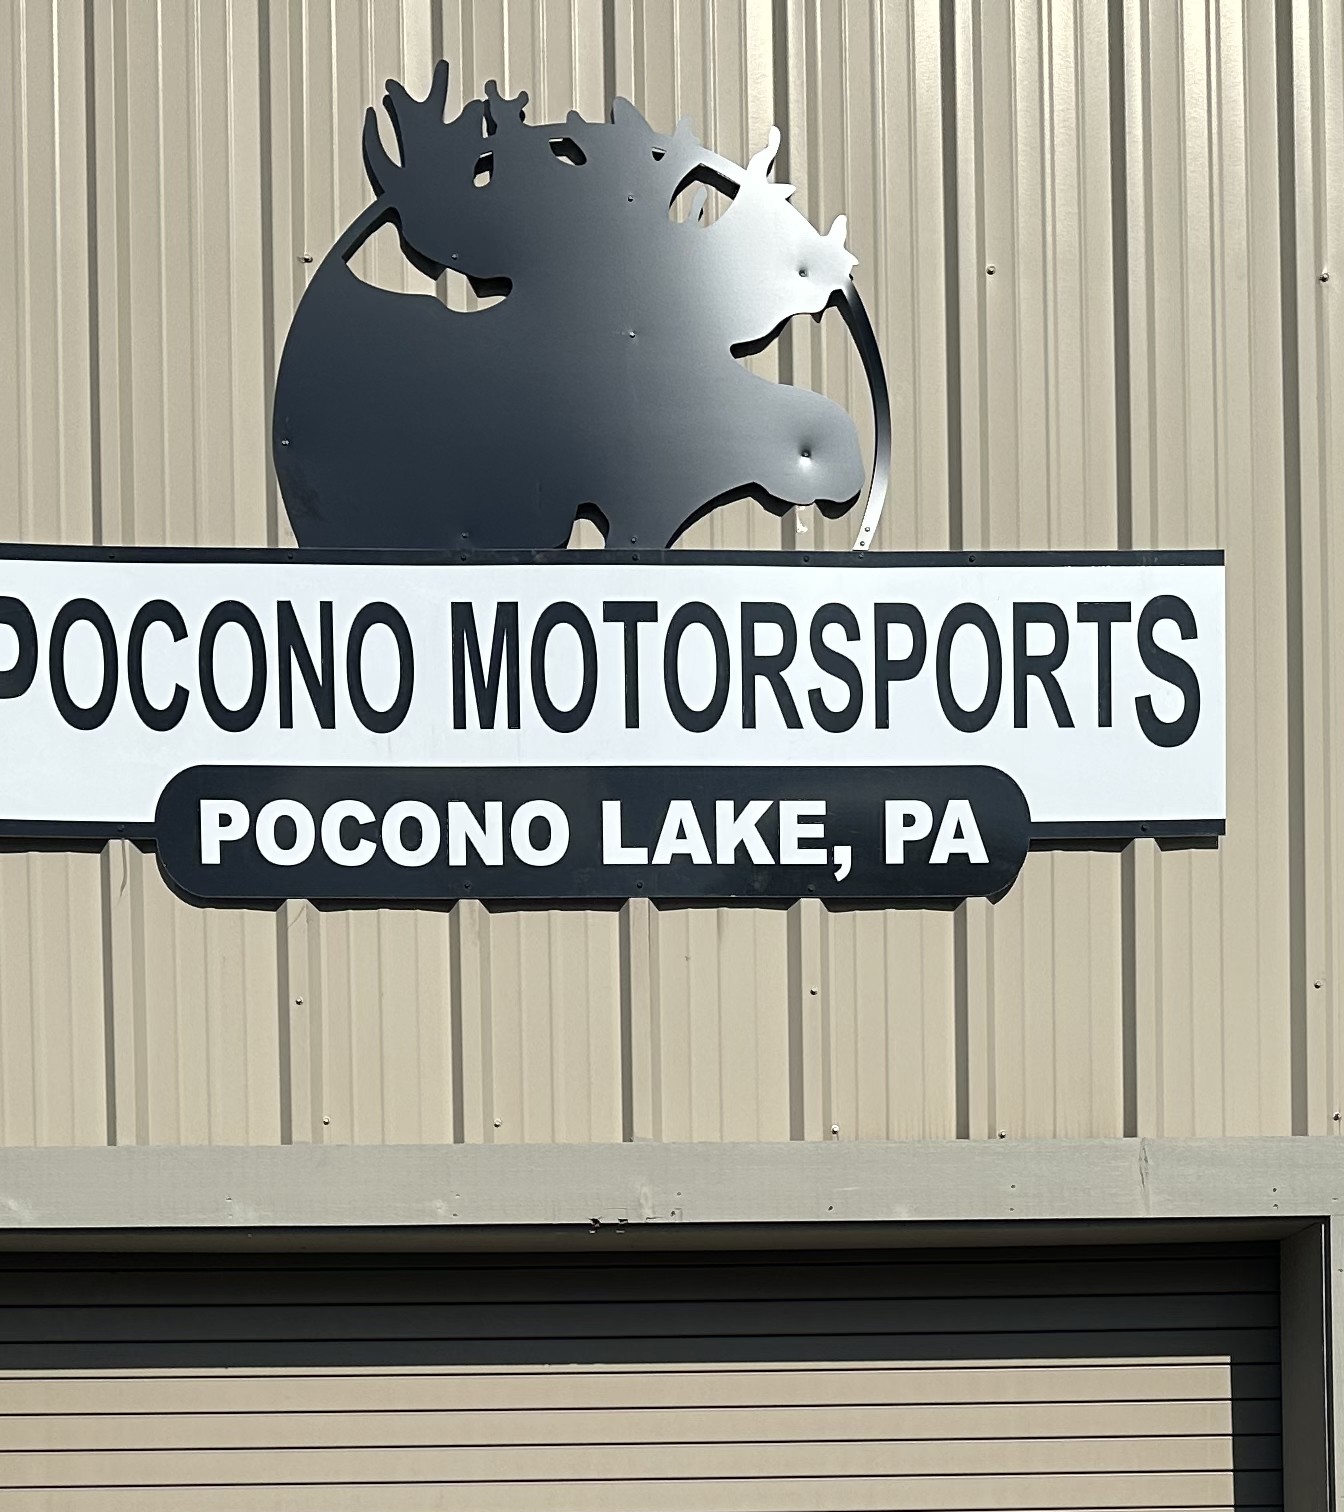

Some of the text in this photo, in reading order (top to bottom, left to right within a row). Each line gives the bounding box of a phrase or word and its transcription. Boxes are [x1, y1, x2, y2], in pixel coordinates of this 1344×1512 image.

[450, 594, 1201, 748] MOTORSPORTS
[199, 799, 990, 882] POCONO LAKE, PA
